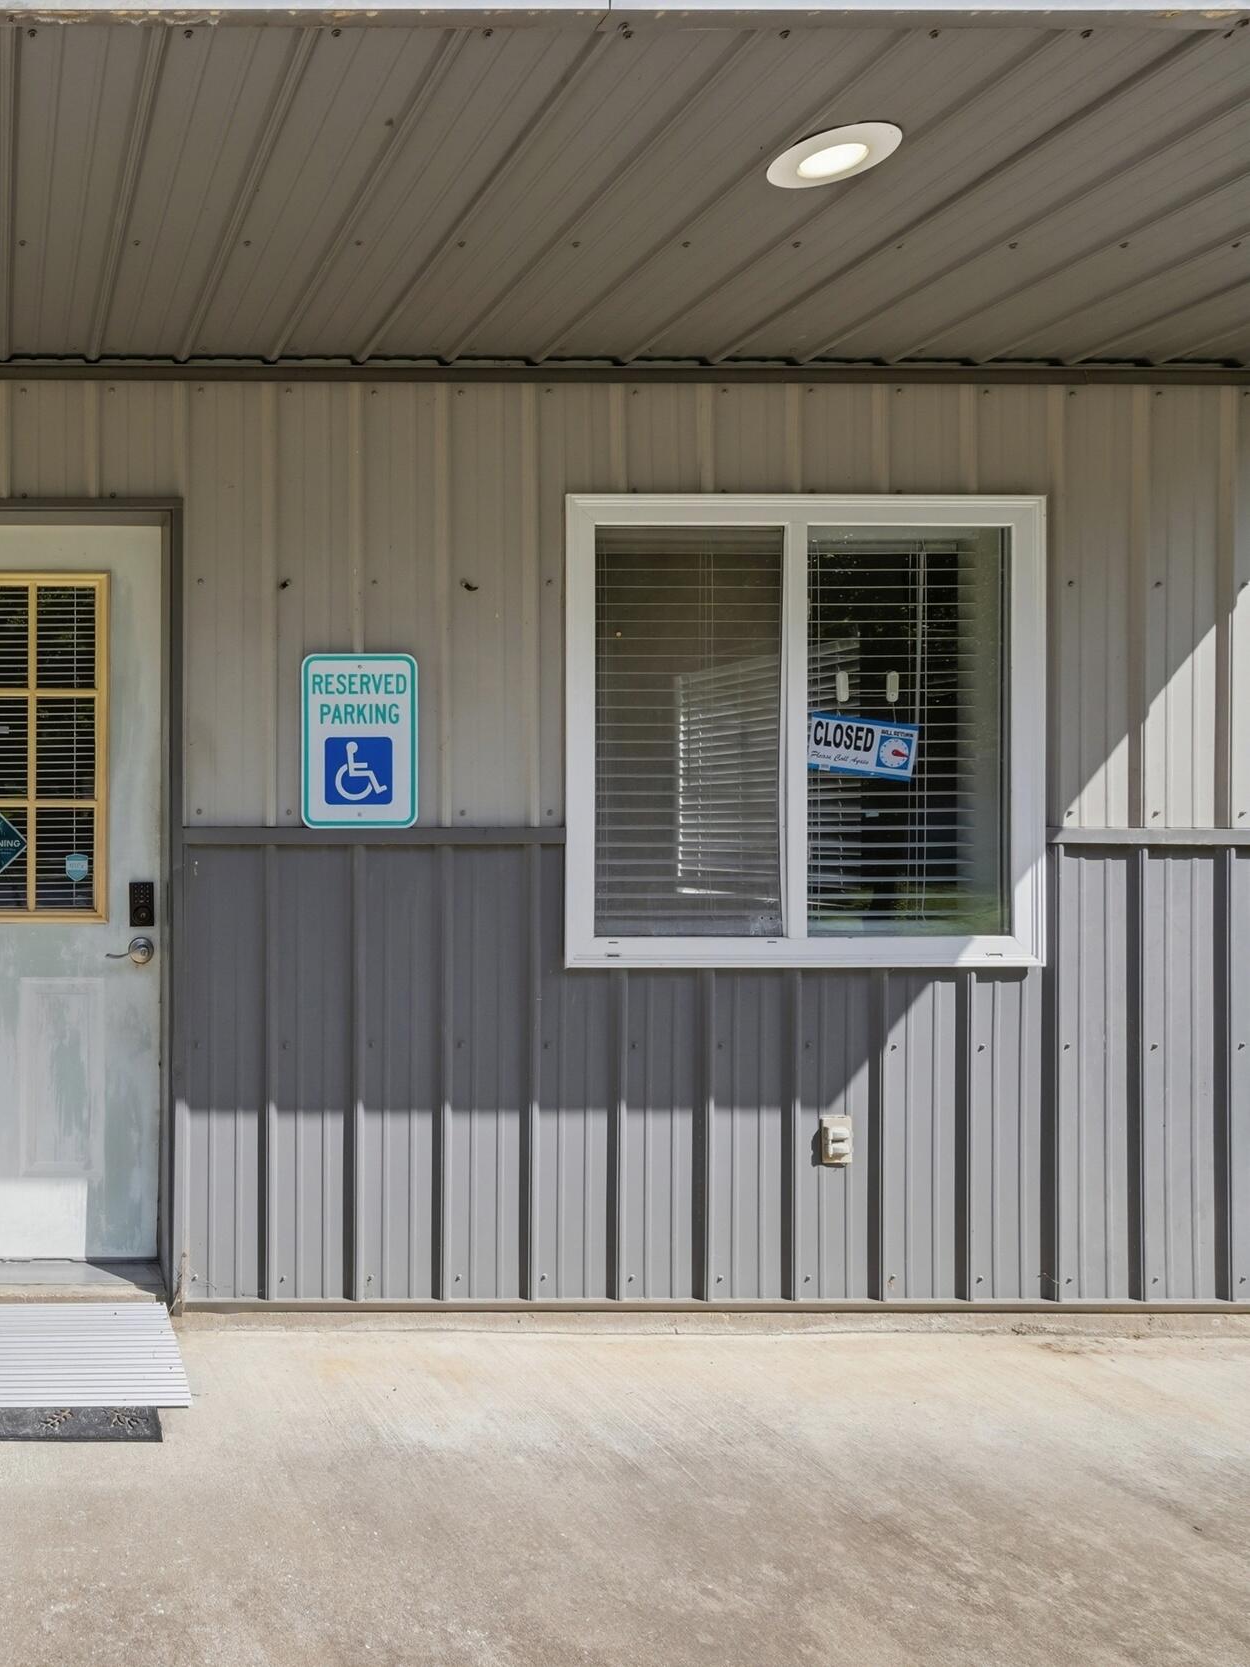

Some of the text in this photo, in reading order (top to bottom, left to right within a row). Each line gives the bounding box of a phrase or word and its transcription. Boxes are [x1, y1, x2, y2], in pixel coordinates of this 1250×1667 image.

[312, 674, 407, 695] RESERVED
[320, 703, 400, 725] PARKING
[813, 720, 875, 753] CLOSED
